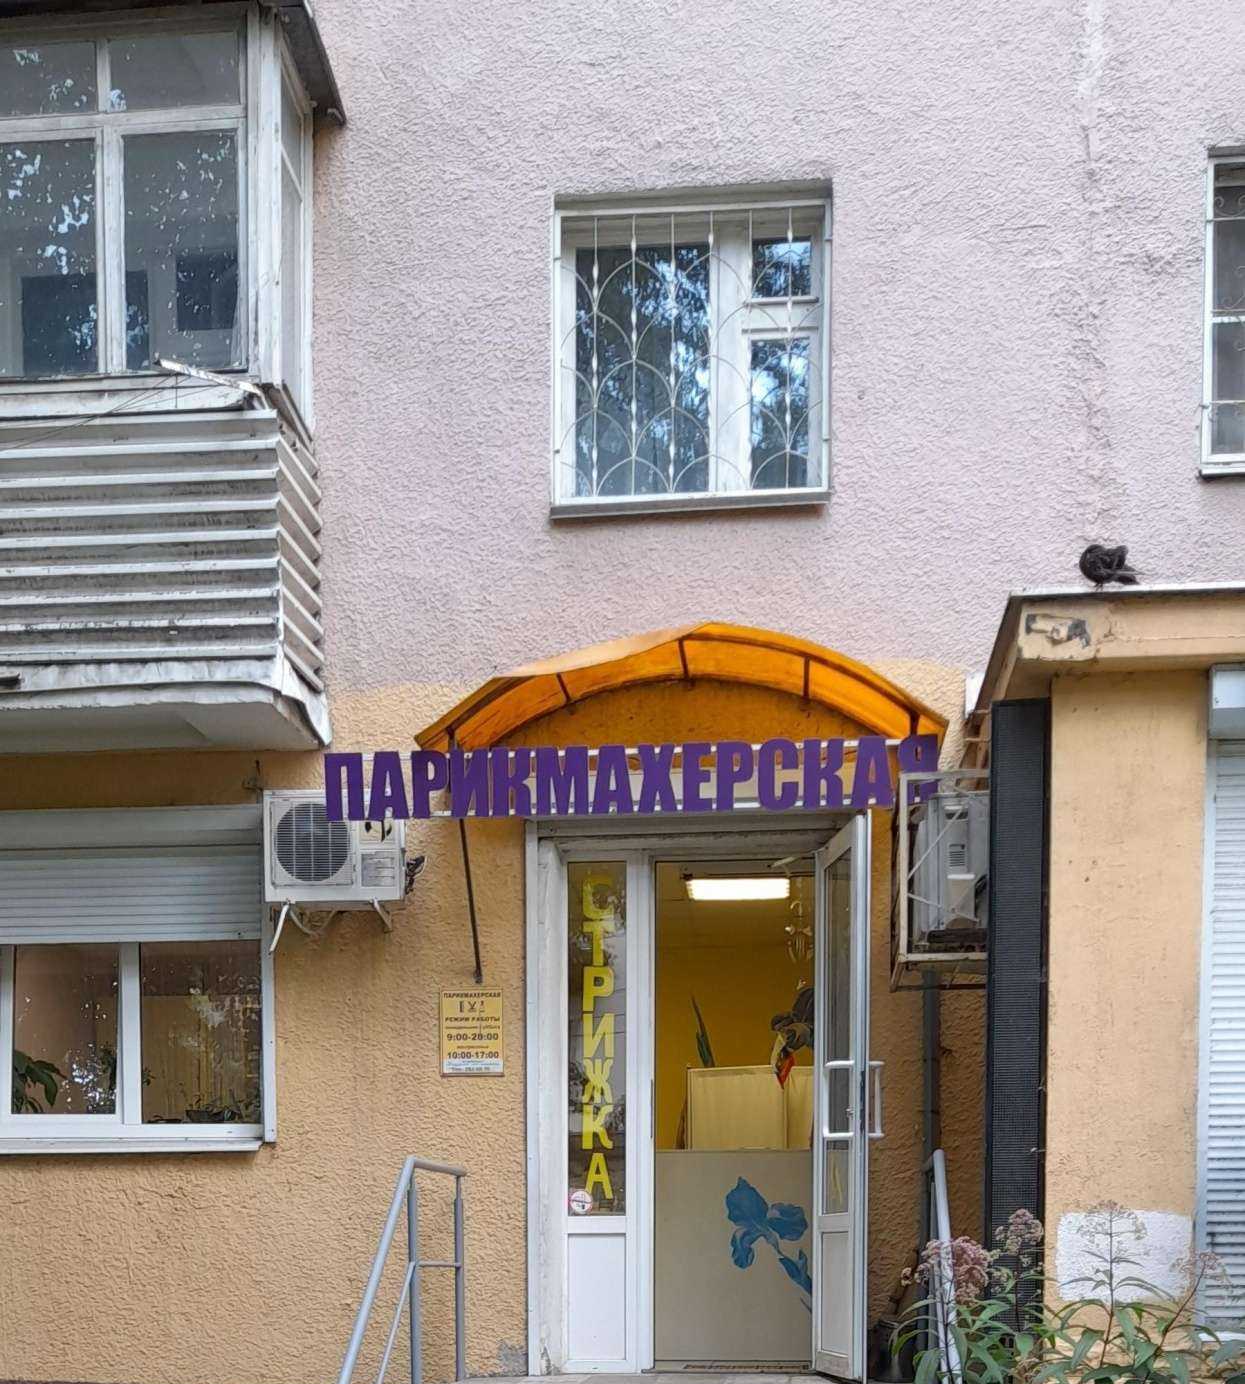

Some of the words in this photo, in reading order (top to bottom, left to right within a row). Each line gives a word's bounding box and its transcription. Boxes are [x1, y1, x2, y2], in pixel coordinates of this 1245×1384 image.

[324, 733, 938, 821] ПАРИКМАХЕРСКАЯ
[446, 1032, 499, 1041] 9:00-20:00
[447, 1051, 499, 1059] 10:00-17:00
[582, 876, 615, 1199] СТРИЖКА
